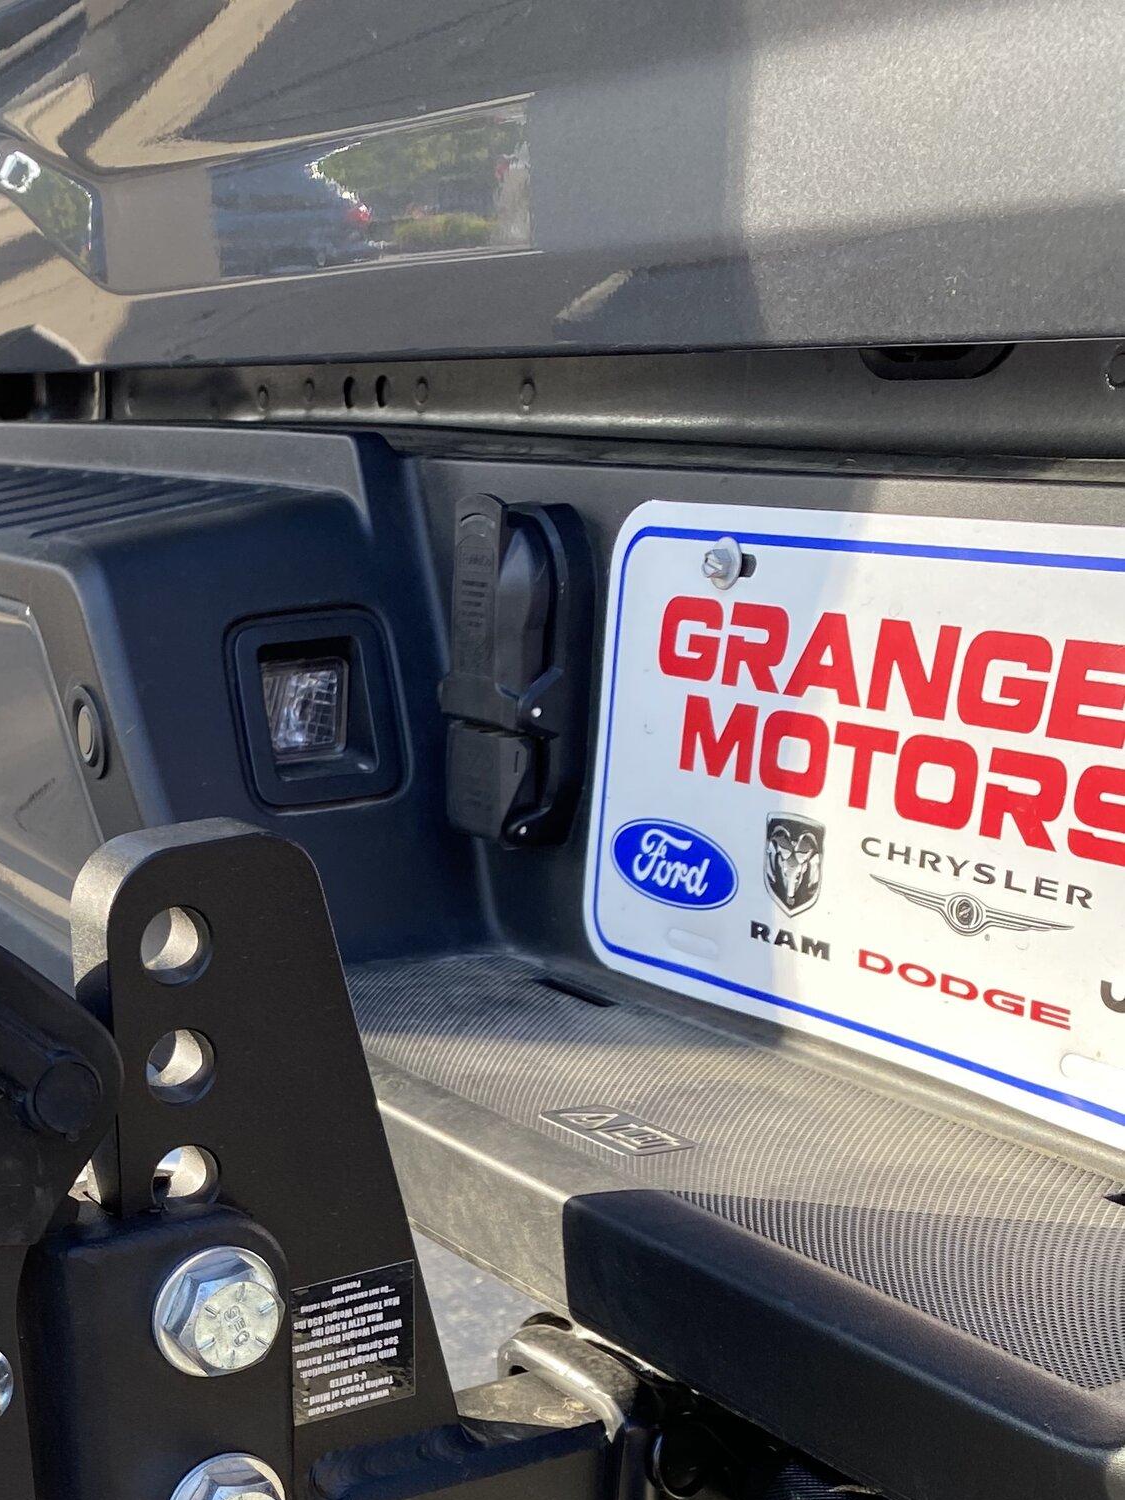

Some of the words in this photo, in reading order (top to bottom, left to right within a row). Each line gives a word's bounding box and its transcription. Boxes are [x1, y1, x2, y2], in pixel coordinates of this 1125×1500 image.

[679, 694, 1125, 867] MOTORS
[632, 828, 711, 897] Ford
[860, 837, 1094, 910] CHRYSLER
[750, 920, 831, 961] RAM
[858, 949, 1071, 1031] DODGE
[353, 1301, 383, 1314] Tongue
[384, 1296, 400, 1307] Max
[324, 1308, 353, 1323] Weight
[367, 1312, 383, 1323] Max
[293, 1320, 306, 1330] lbs
[371, 1319, 402, 1334] Without
[311, 1327, 324, 1337] lbs
[342, 1327, 370, 1341] Weight
[357, 1340, 383, 1353] Spring
[384, 1336, 399, 1346] See
[323, 1352, 335, 1361] for
[336, 1347, 356, 1358] Arms
[378, 1347, 397, 1359] With
[296, 1355, 322, 1368] Rating
[349, 1352, 378, 1367] Weight
[365, 1375, 393, 1389] Towing
[341, 1383, 365, 1395] Peace
[309, 1392, 330, 1406] Mind
